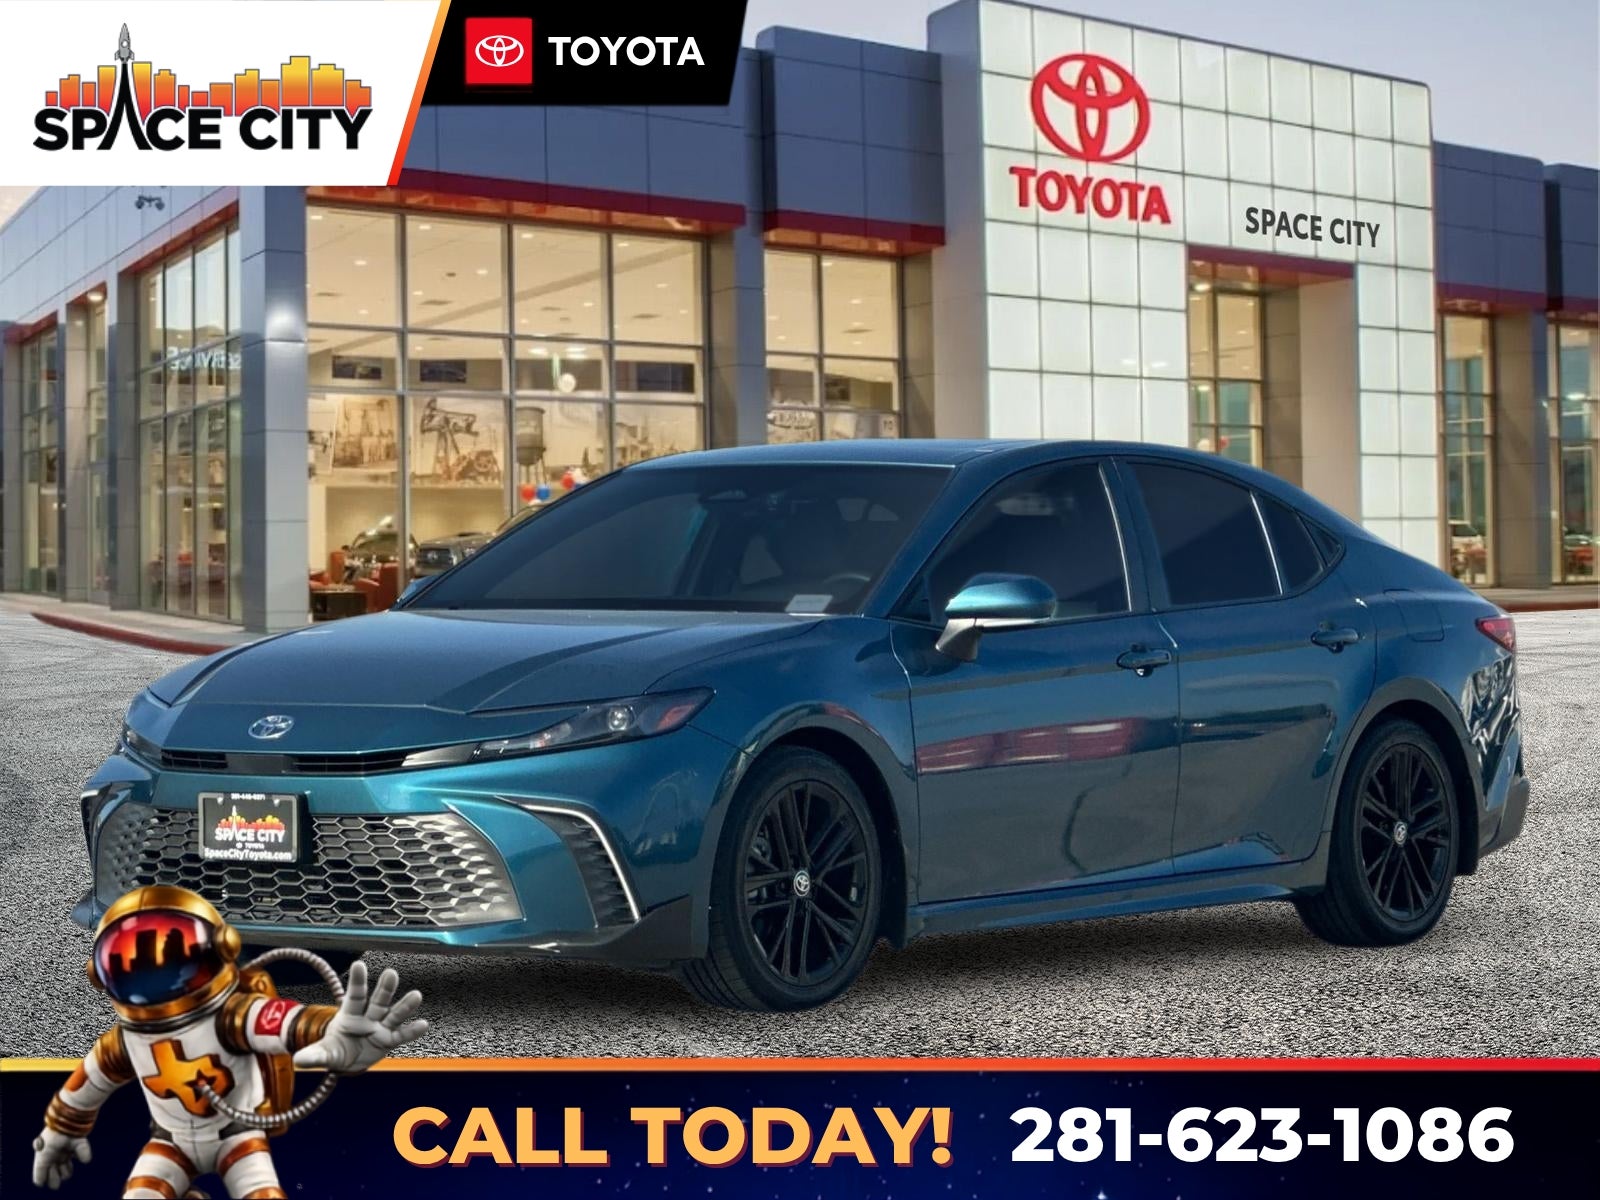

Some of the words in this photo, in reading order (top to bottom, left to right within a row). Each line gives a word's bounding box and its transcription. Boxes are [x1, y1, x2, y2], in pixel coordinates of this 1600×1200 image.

[1008, 166, 1172, 225] TOYOTA
[1245, 206, 1323, 242] SPACE
[1329, 217, 1381, 248] CITY
[214, 827, 255, 842] SPACE
[257, 828, 286, 843] CITY
[204, 847, 292, 861] SpaceCityToyota.com
